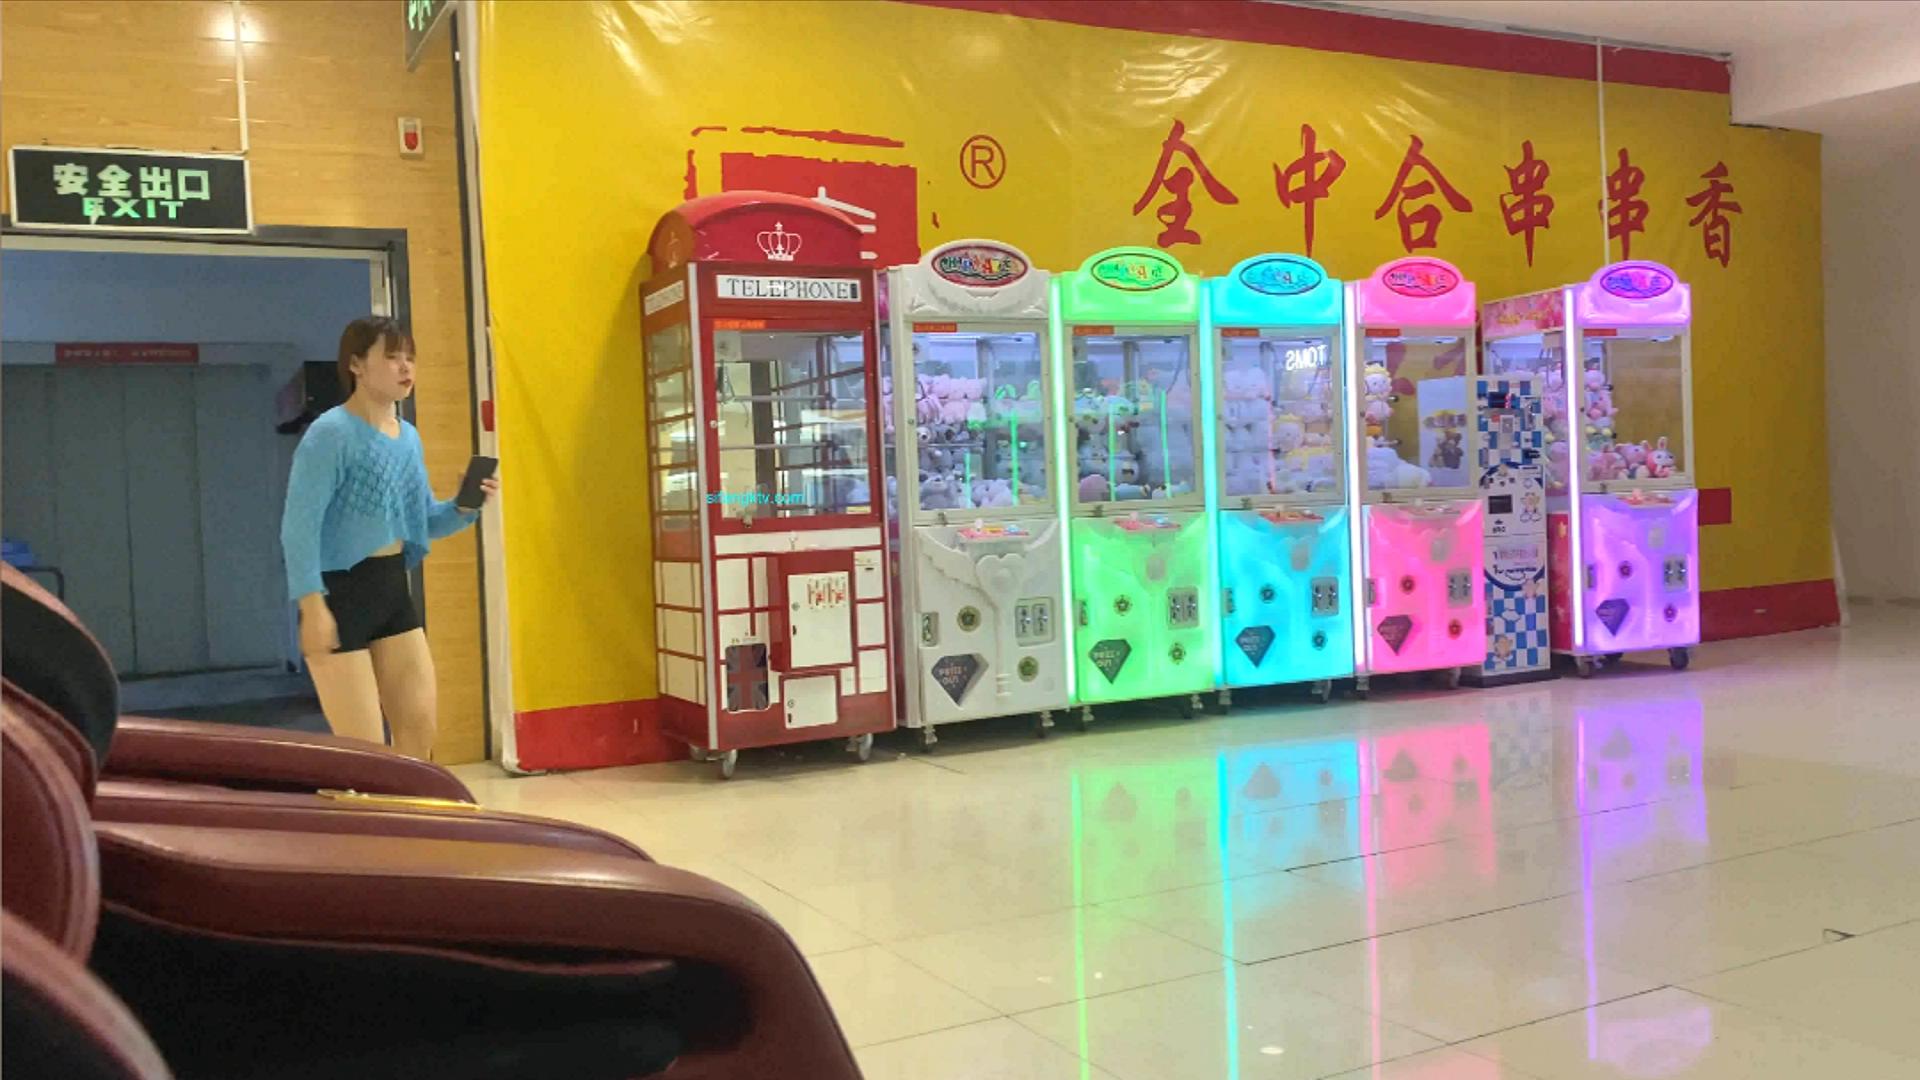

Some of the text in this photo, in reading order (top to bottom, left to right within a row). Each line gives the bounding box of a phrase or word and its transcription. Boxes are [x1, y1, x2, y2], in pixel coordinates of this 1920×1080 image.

[53, 163, 210, 200] 安全出口
[1133, 118, 1744, 269] 全中合串串香
[82, 197, 184, 220] EXIT
[727, 278, 849, 299] TELEPHONE
